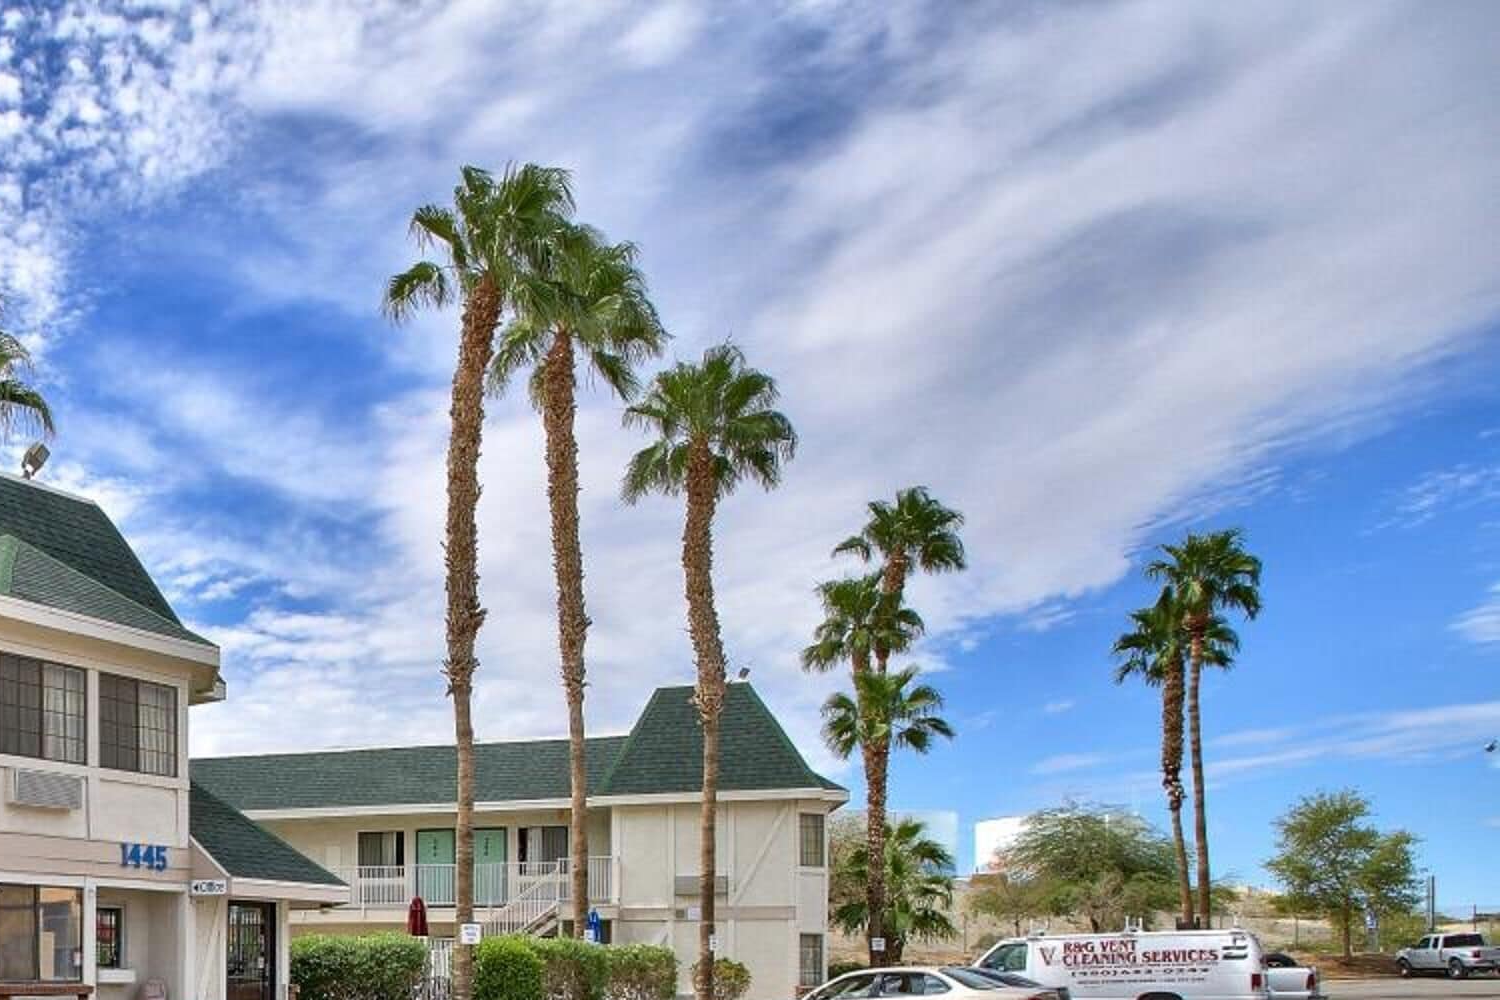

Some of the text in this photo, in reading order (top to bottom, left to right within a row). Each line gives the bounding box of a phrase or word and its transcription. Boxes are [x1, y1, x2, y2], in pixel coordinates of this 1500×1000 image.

[121, 843, 167, 872] 1445
[1099, 940, 1138, 952] VENT
[1062, 952, 1137, 967] CLEANING
[1141, 949, 1219, 964] SERVICES
